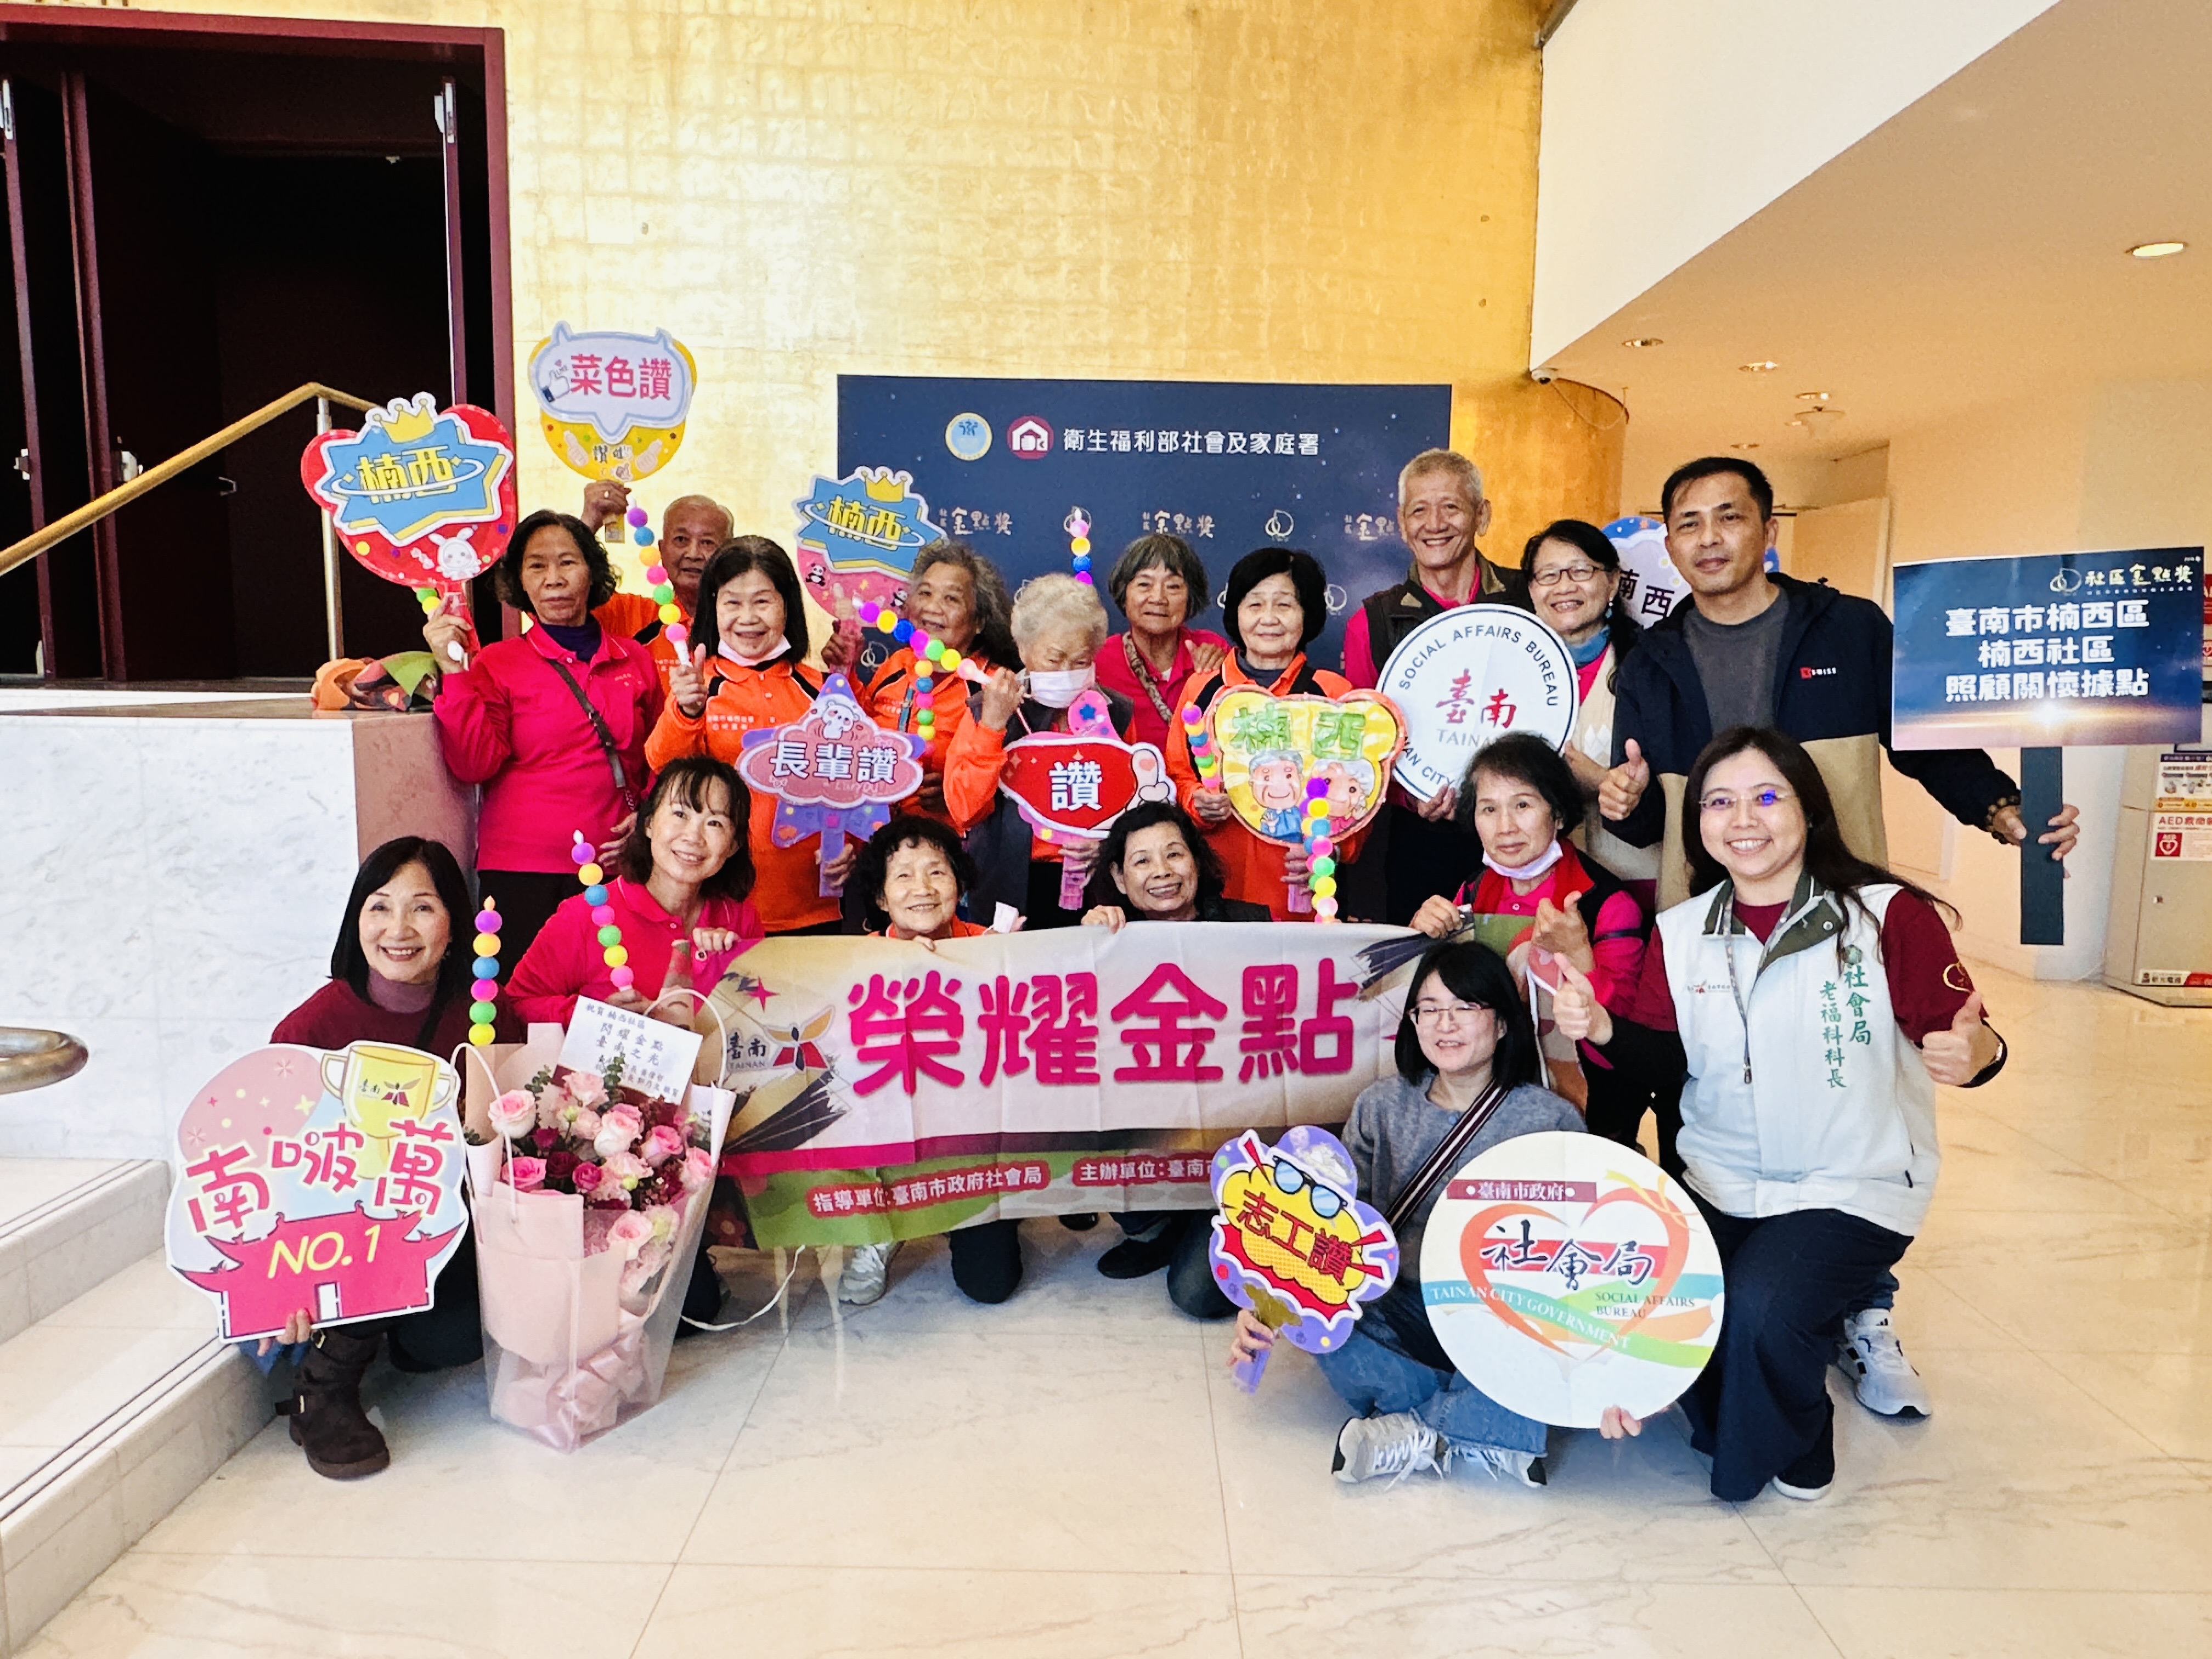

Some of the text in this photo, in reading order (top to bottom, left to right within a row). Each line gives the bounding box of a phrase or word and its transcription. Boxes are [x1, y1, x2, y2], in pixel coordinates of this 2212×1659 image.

[571, 353, 672, 400] 菜色讚
[1064, 428, 1320, 456] 衛生福利部社會及家庭署
[355, 445, 459, 504] 楠西
[826, 494, 907, 551] 楠西
[1355, 512, 1395, 541] 金點
[1945, 599, 2150, 637] 臺南市楠西區
[1399, 624, 1558, 707] SOCIAL AFFAIRS BUREAU
[1977, 635, 2115, 668] 楠西社區
[1435, 668, 1517, 729] 臺南
[1945, 667, 2150, 703] 照顧關懷據點
[1436, 728, 1499, 748] TAINA
[769, 741, 899, 785] 長輩讚
[1049, 761, 1103, 811] 讚
[848, 958, 1359, 1097] 榮耀金點
[1844, 964, 1871, 1046] 社會局
[726, 1031, 767, 1060] 臺南
[1820, 980, 1847, 1088] 老福科科長
[185, 1120, 454, 1233] 南啵萬
[1478, 1183, 1566, 1201] 臺南市政府
[1237, 1189, 1353, 1286] 志工讚
[1479, 1219, 1655, 1290] 社會局
[1432, 1286, 1631, 1348] TAINAN CITY GOVERNMENT
[1595, 1290, 1695, 1308] SOCIAL AFFAIRS
[1595, 1306, 1647, 1318] BUREAU
